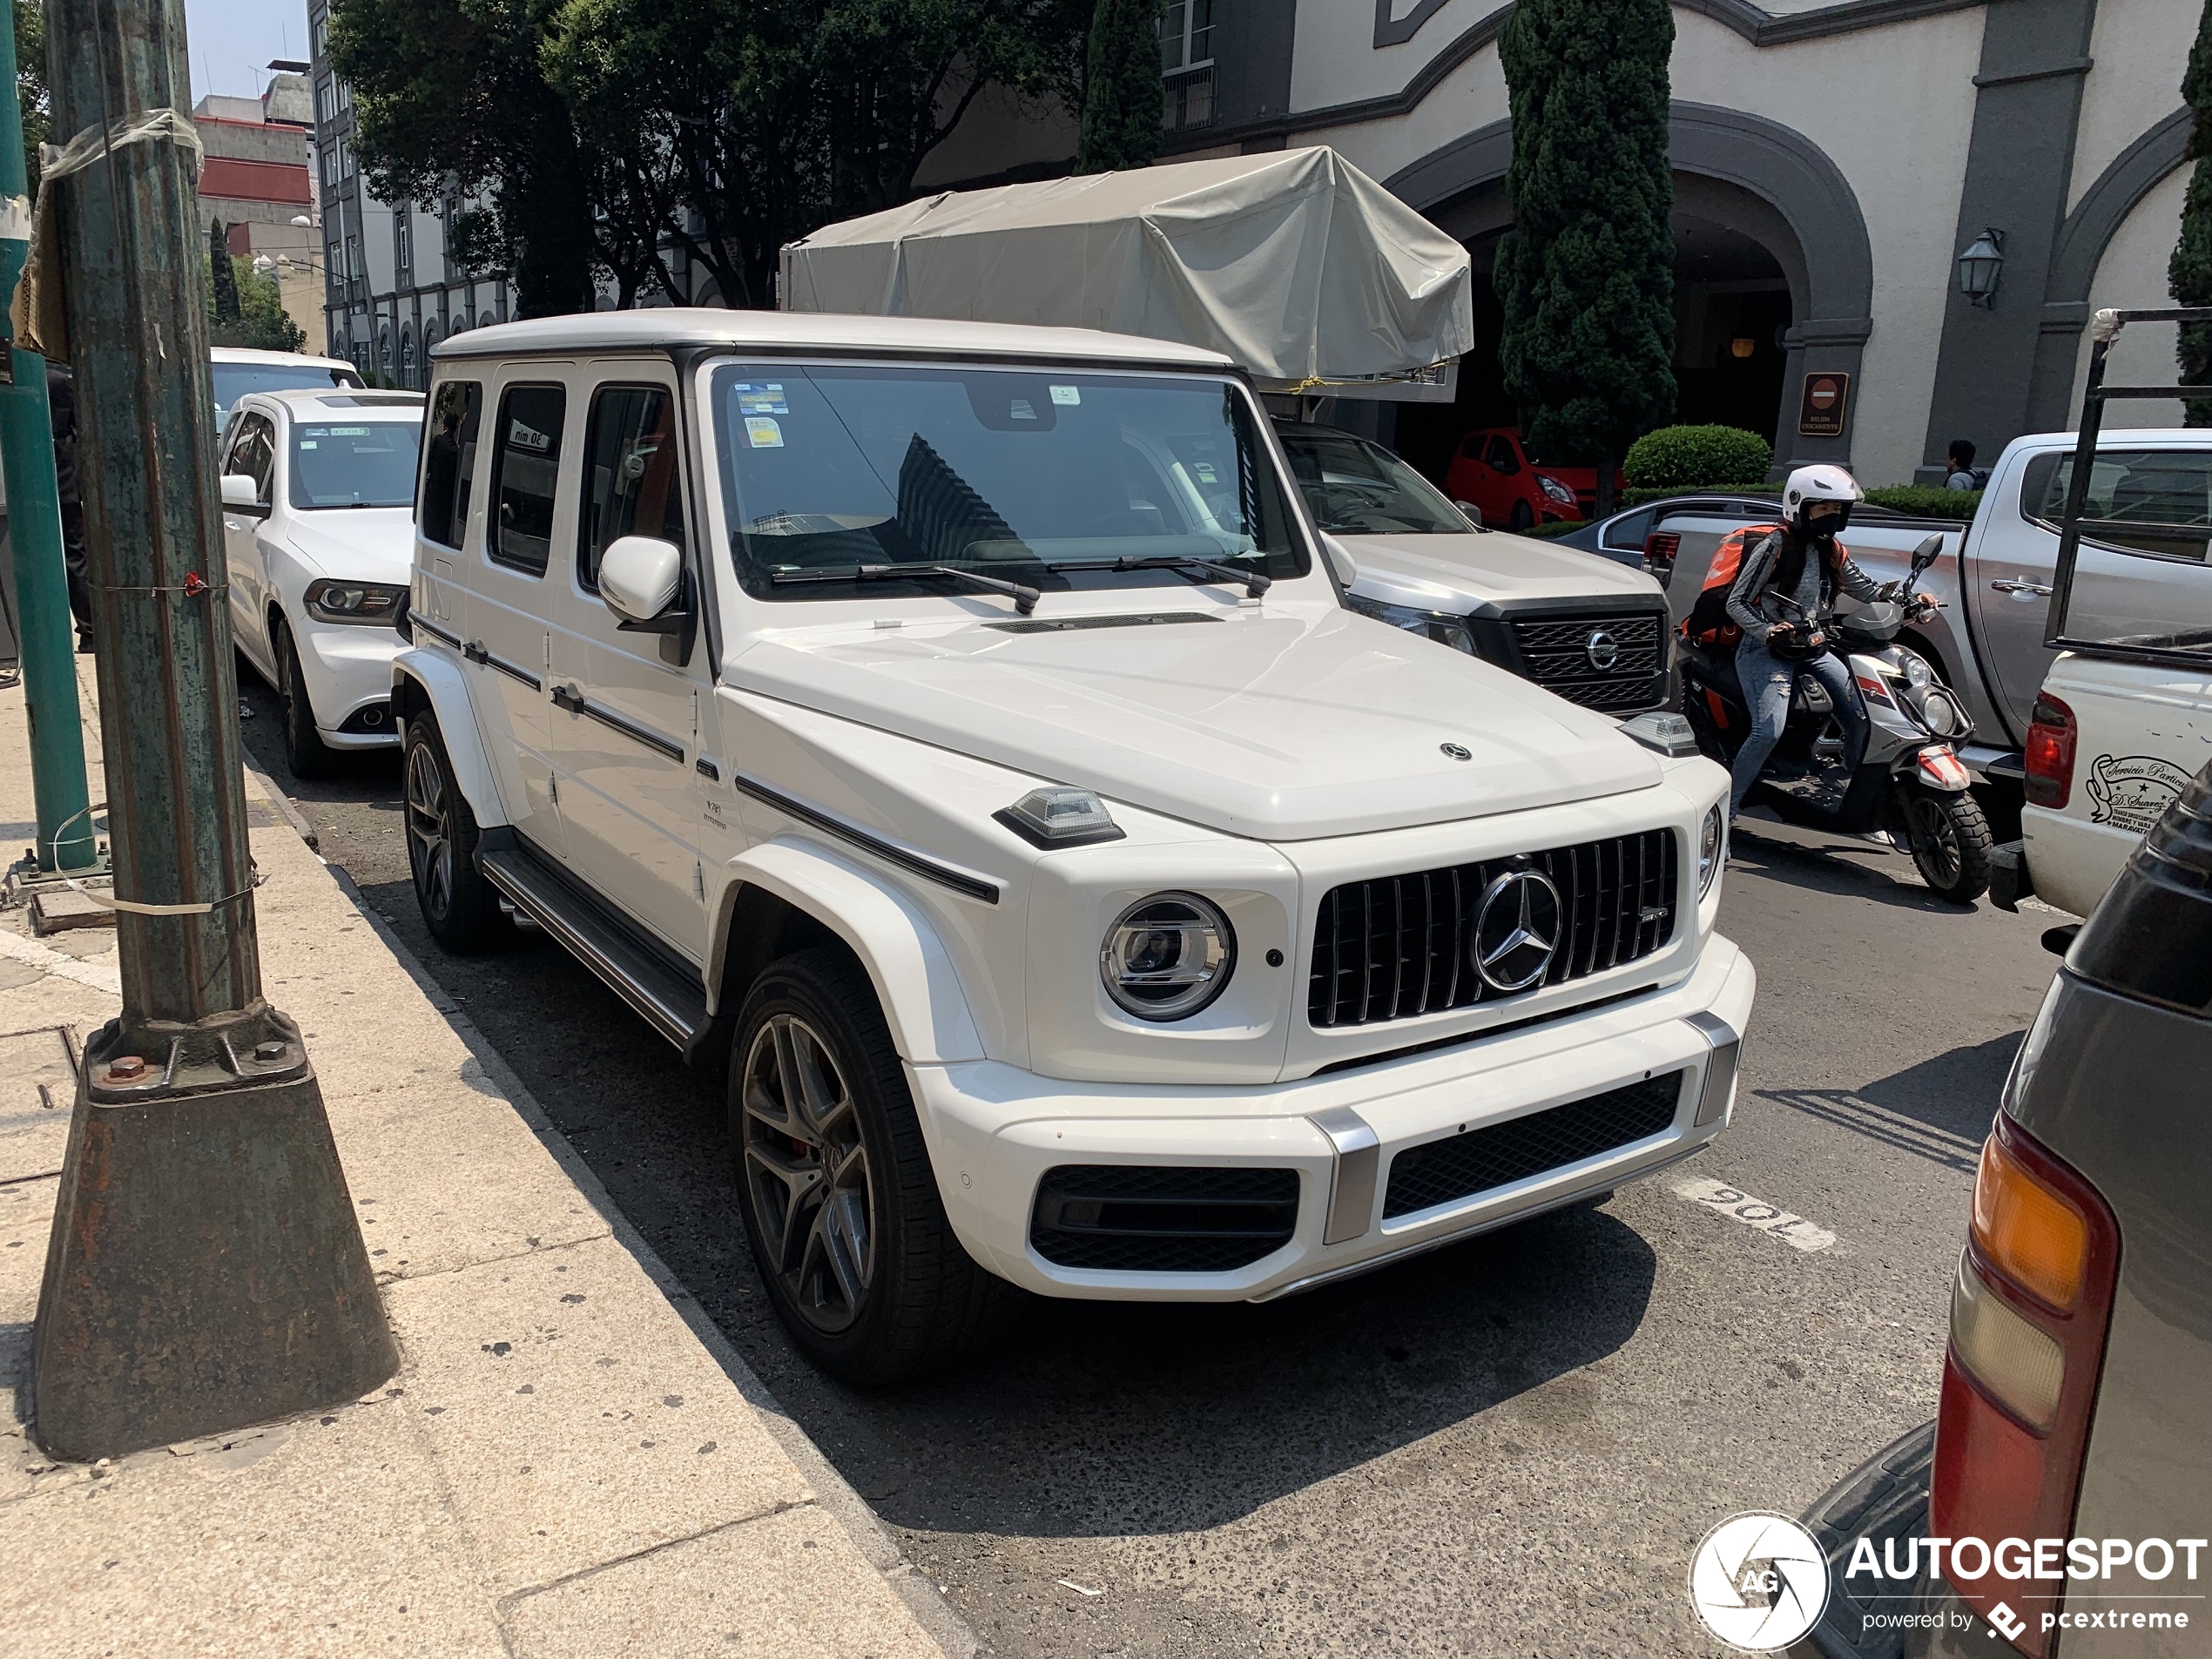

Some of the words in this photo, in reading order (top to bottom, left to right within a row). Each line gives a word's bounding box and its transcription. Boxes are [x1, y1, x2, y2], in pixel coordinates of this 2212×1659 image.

[2106, 761, 2144, 778] Servicio
[2148, 763, 2188, 789] Particu
[2137, 820, 2151, 829] VARA
